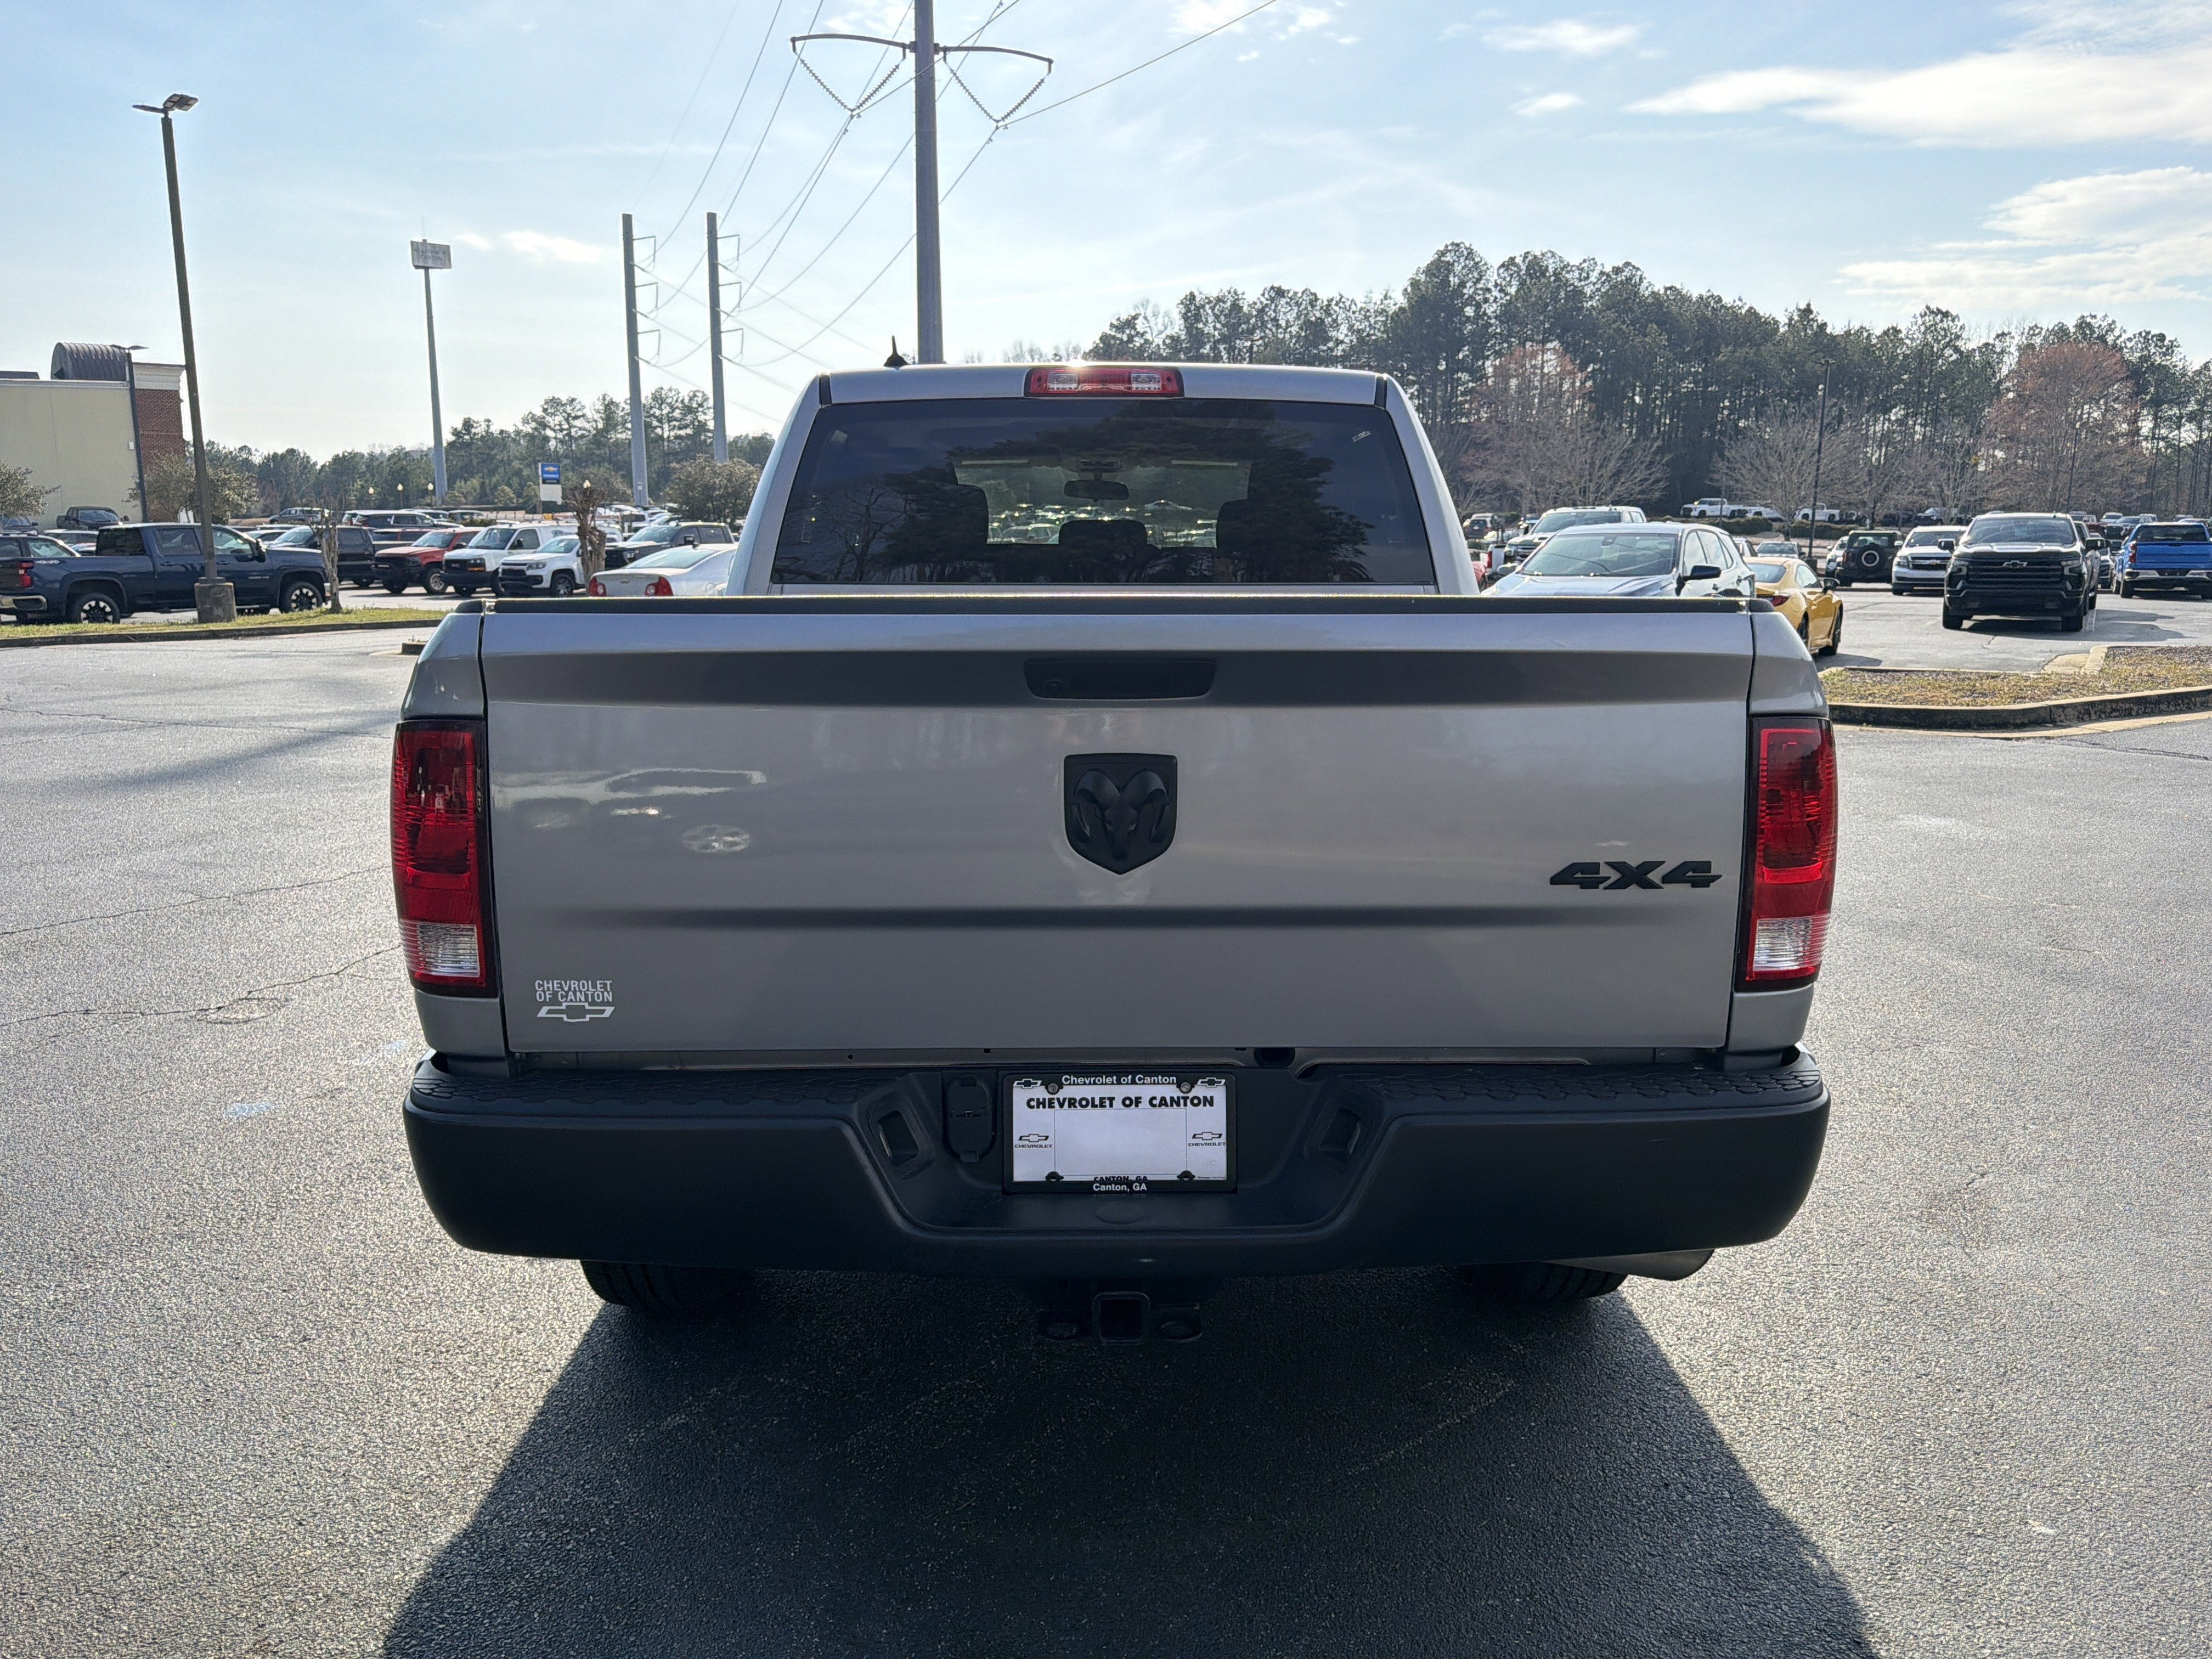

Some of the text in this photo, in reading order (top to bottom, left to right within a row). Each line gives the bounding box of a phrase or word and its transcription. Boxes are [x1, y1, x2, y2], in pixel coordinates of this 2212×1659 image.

[535, 980, 613, 991] CHEVROLET
[536, 991, 613, 1002] OF CANTON
[1062, 1074, 1177, 1085] Chevrolet of Canton
[1026, 1095, 1214, 1109] CHEVROLET OF CANTON
[1092, 1183, 1148, 1192] Canton, GA
